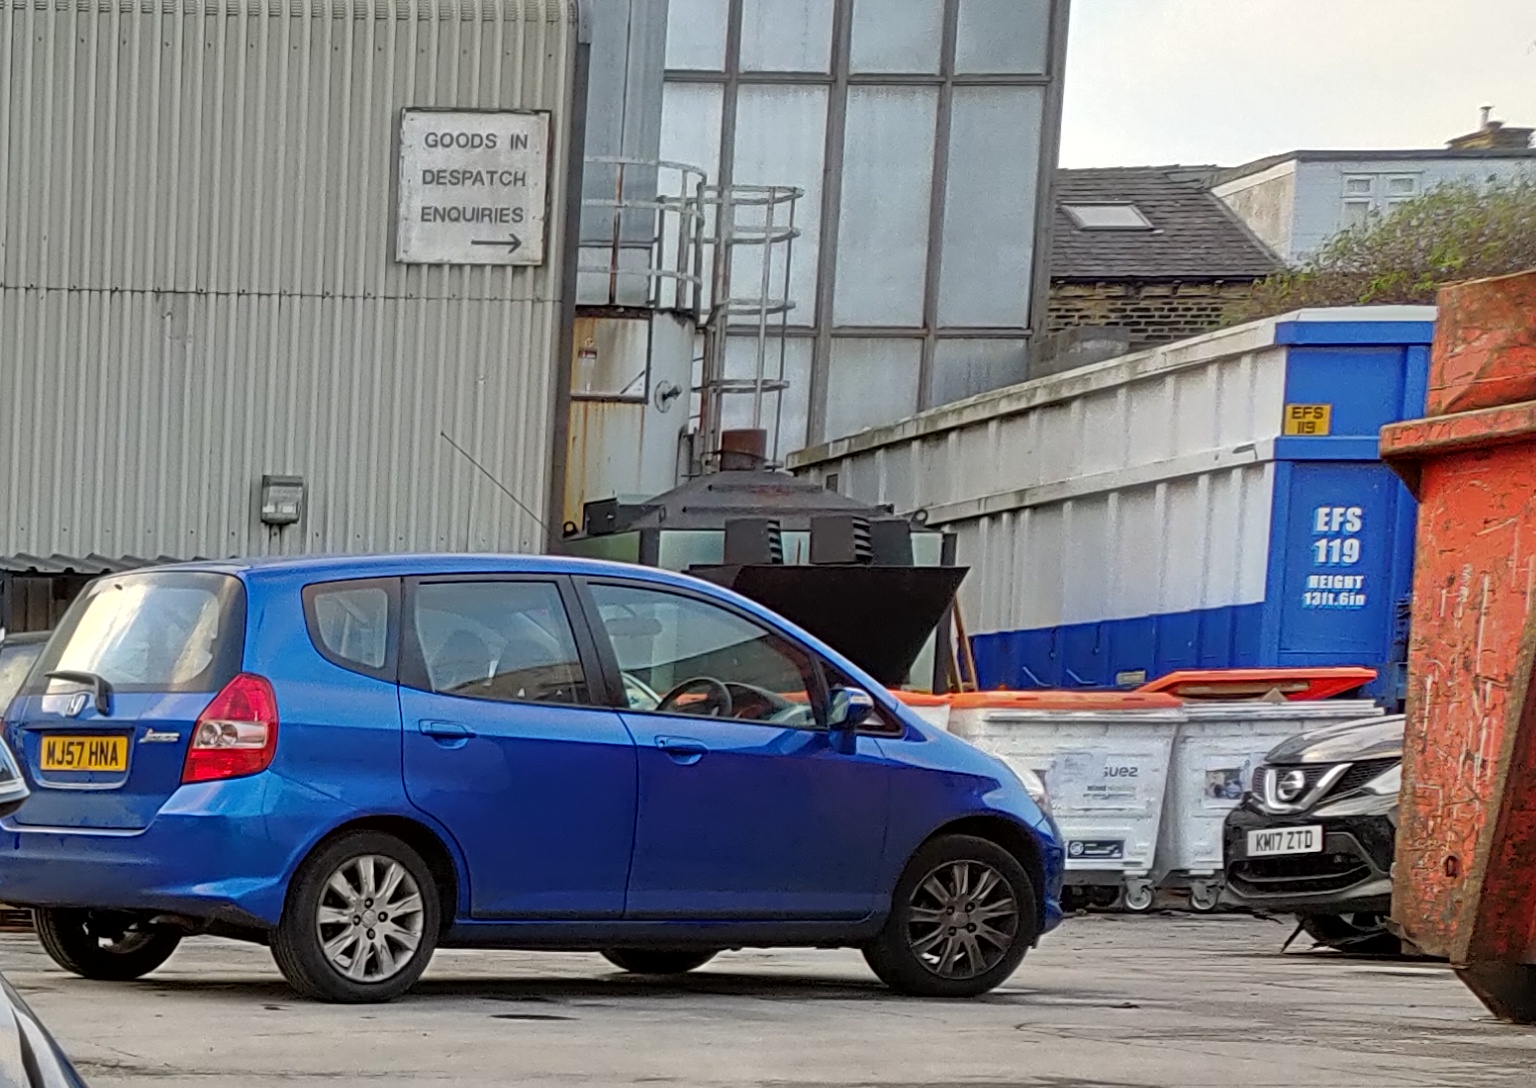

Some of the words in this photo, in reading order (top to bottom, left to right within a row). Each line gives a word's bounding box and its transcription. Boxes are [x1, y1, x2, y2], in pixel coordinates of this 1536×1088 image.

[424, 132, 497, 149] GOODS
[510, 133, 528, 150] IN
[422, 169, 526, 187] DESPATCH
[420, 206, 524, 224] ENQUIRIES
[1291, 406, 1324, 420] EFS
[1297, 421, 1316, 434] 119
[1314, 507, 1363, 533] EFS
[1313, 538, 1360, 564] 119
[1307, 575, 1365, 589] HEIGHT
[46, 740, 85, 767] MJ57
[88, 740, 119, 767] HNA
[1286, 829, 1313, 851] ZTD
